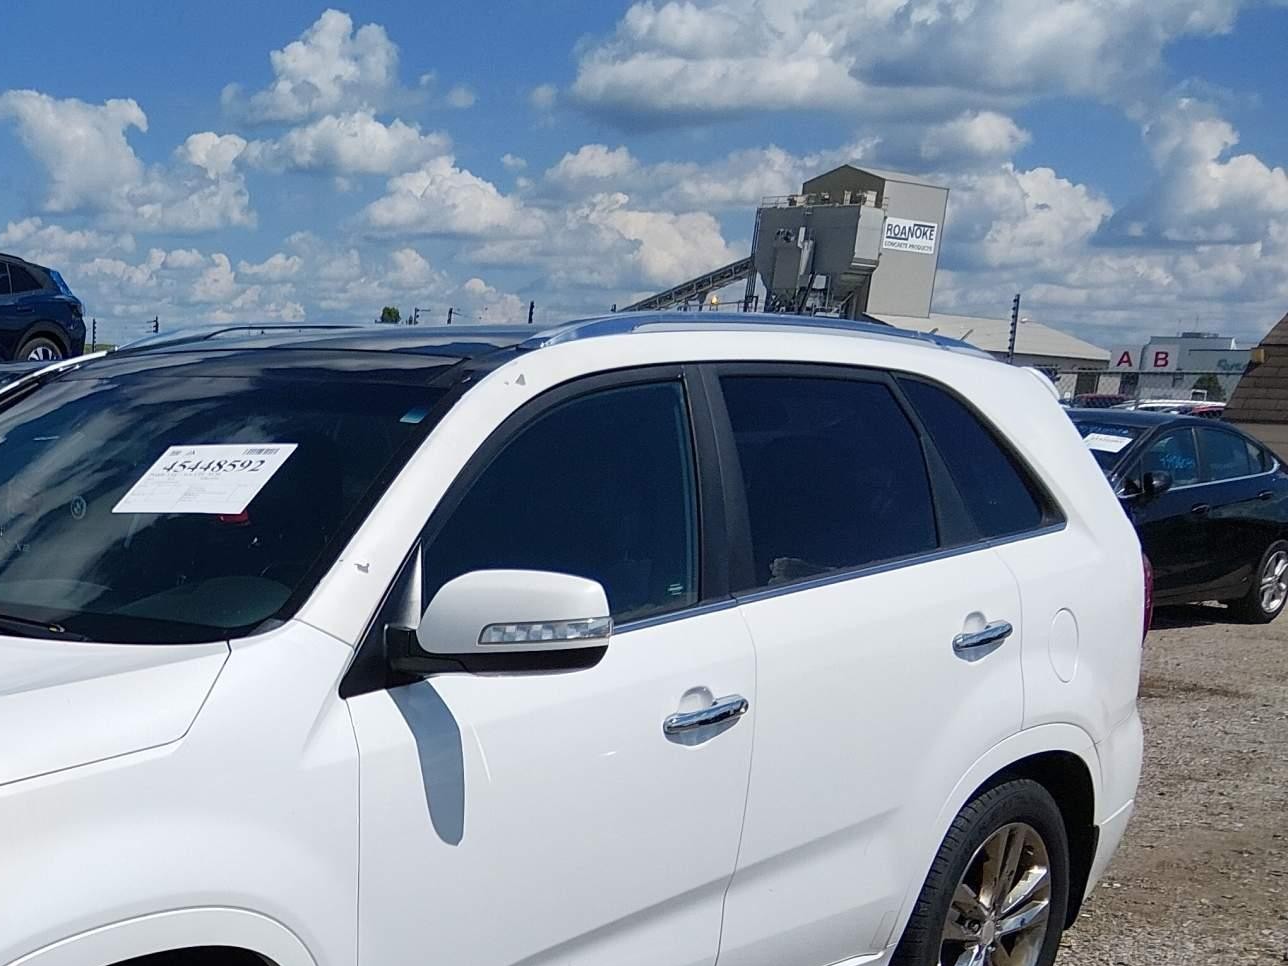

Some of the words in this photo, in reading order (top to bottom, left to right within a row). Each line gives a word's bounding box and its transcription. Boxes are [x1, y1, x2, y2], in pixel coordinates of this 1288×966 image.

[886, 223, 935, 241] ROANOKE
[1116, 351, 1133, 367] A
[1153, 351, 1169, 368] B
[163, 459, 265, 473] 45448592
